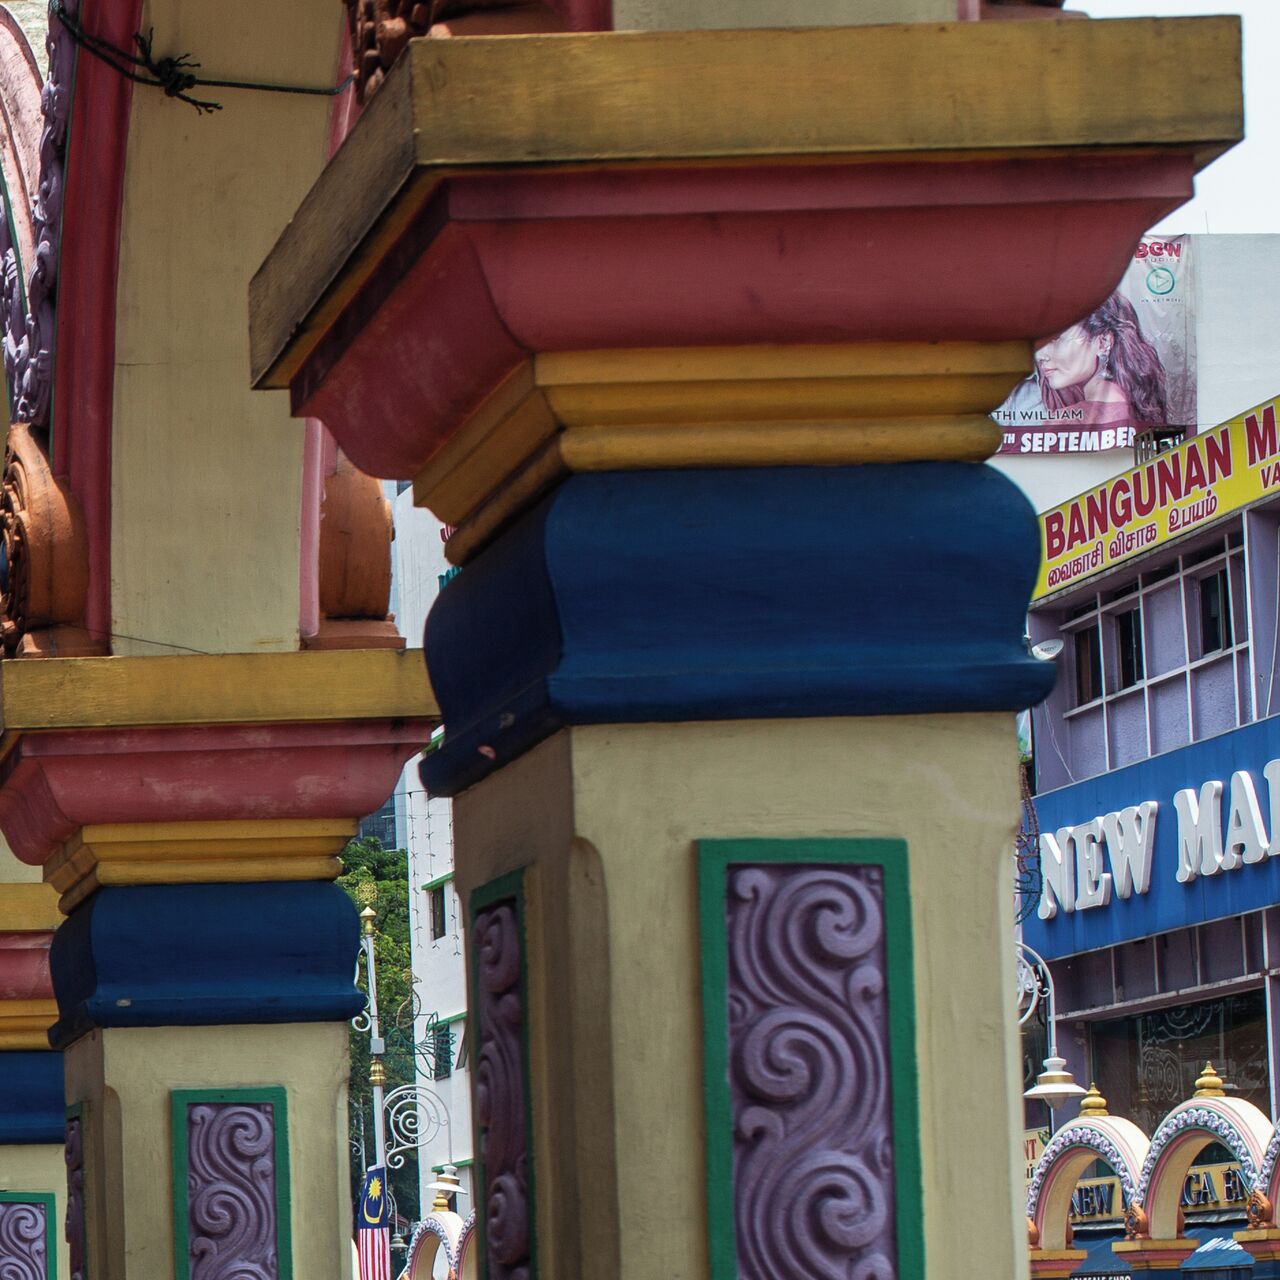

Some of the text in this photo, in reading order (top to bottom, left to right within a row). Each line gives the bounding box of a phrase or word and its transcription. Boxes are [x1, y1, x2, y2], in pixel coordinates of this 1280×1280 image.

[1020, 409, 1084, 421] WILLIAM
[1020, 426, 1137, 454] SEPTEMBER
[1045, 404, 1280, 561] BANGUNAN M
[1168, 490, 1218, 534] உபயம்
[1038, 801, 1159, 920] NEW
